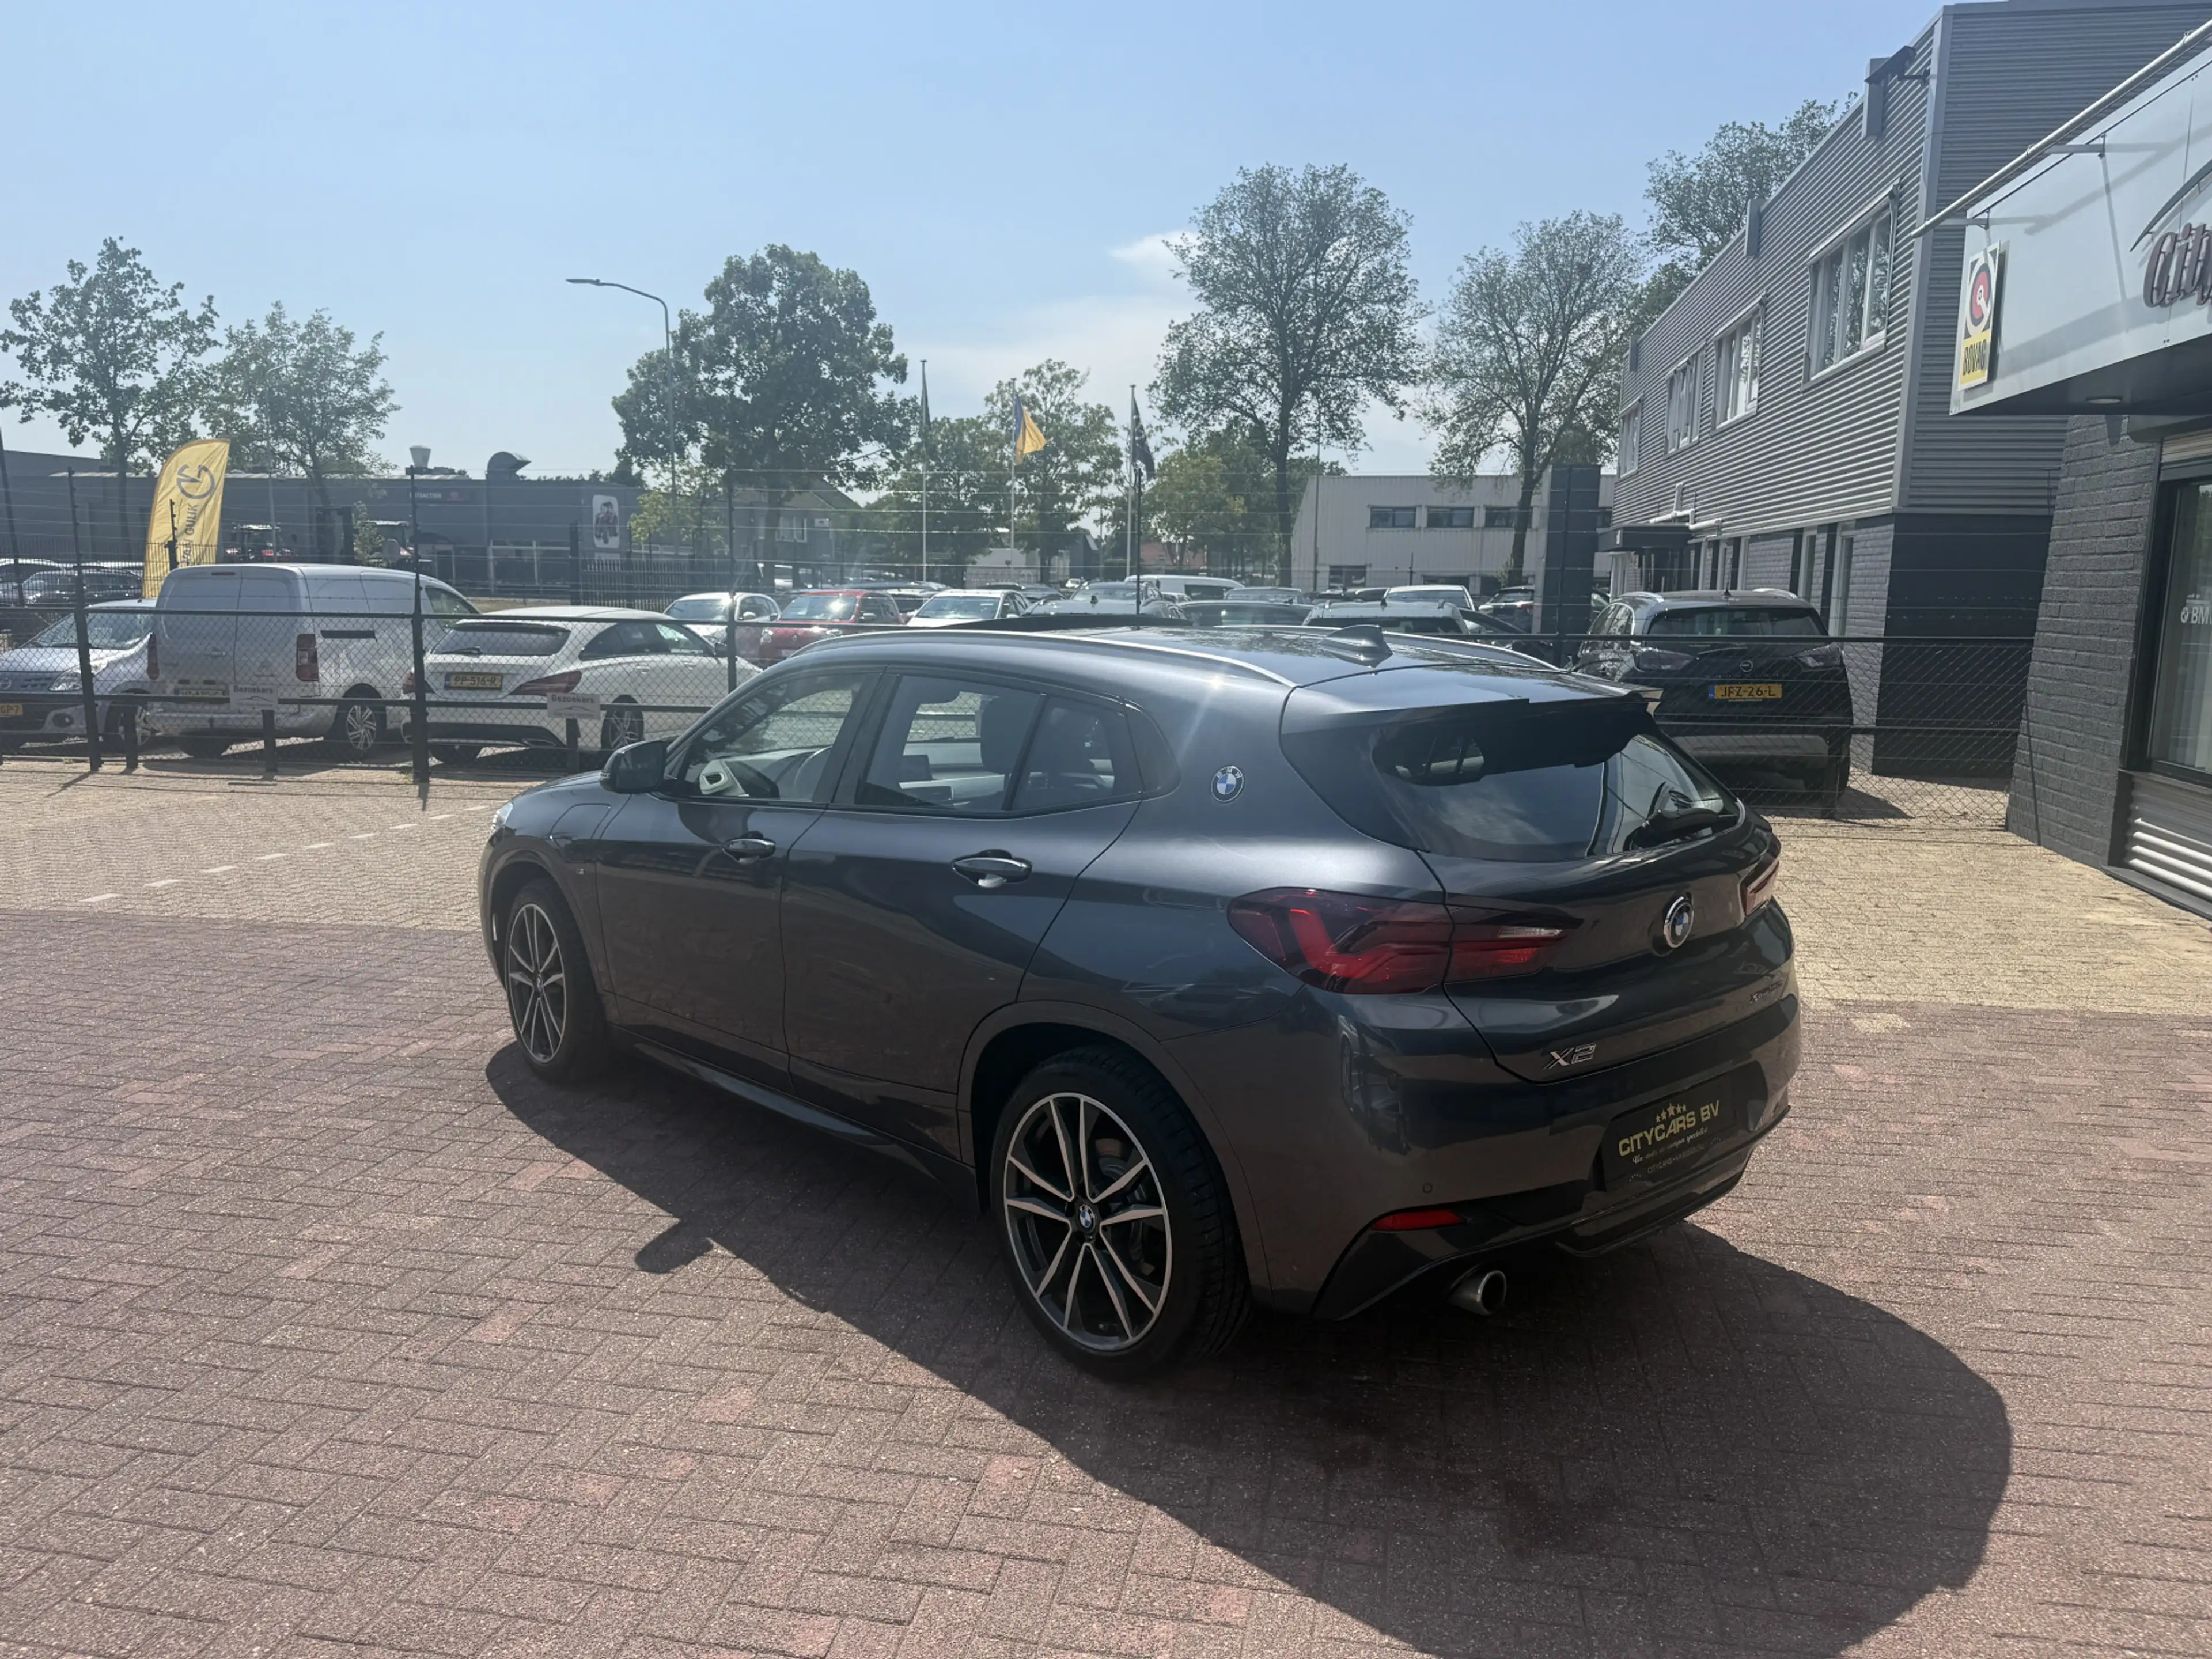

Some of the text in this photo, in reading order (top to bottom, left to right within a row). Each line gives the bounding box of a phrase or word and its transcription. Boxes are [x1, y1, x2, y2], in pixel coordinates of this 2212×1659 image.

[1963, 339, 1987, 376] BOVAG
[185, 503, 198, 535] GULIK
[1721, 685, 1775, 698] JFZ-26-L
[1543, 1042, 1597, 1070] X2
[1618, 1099, 1719, 1157] CITYCARS BV
